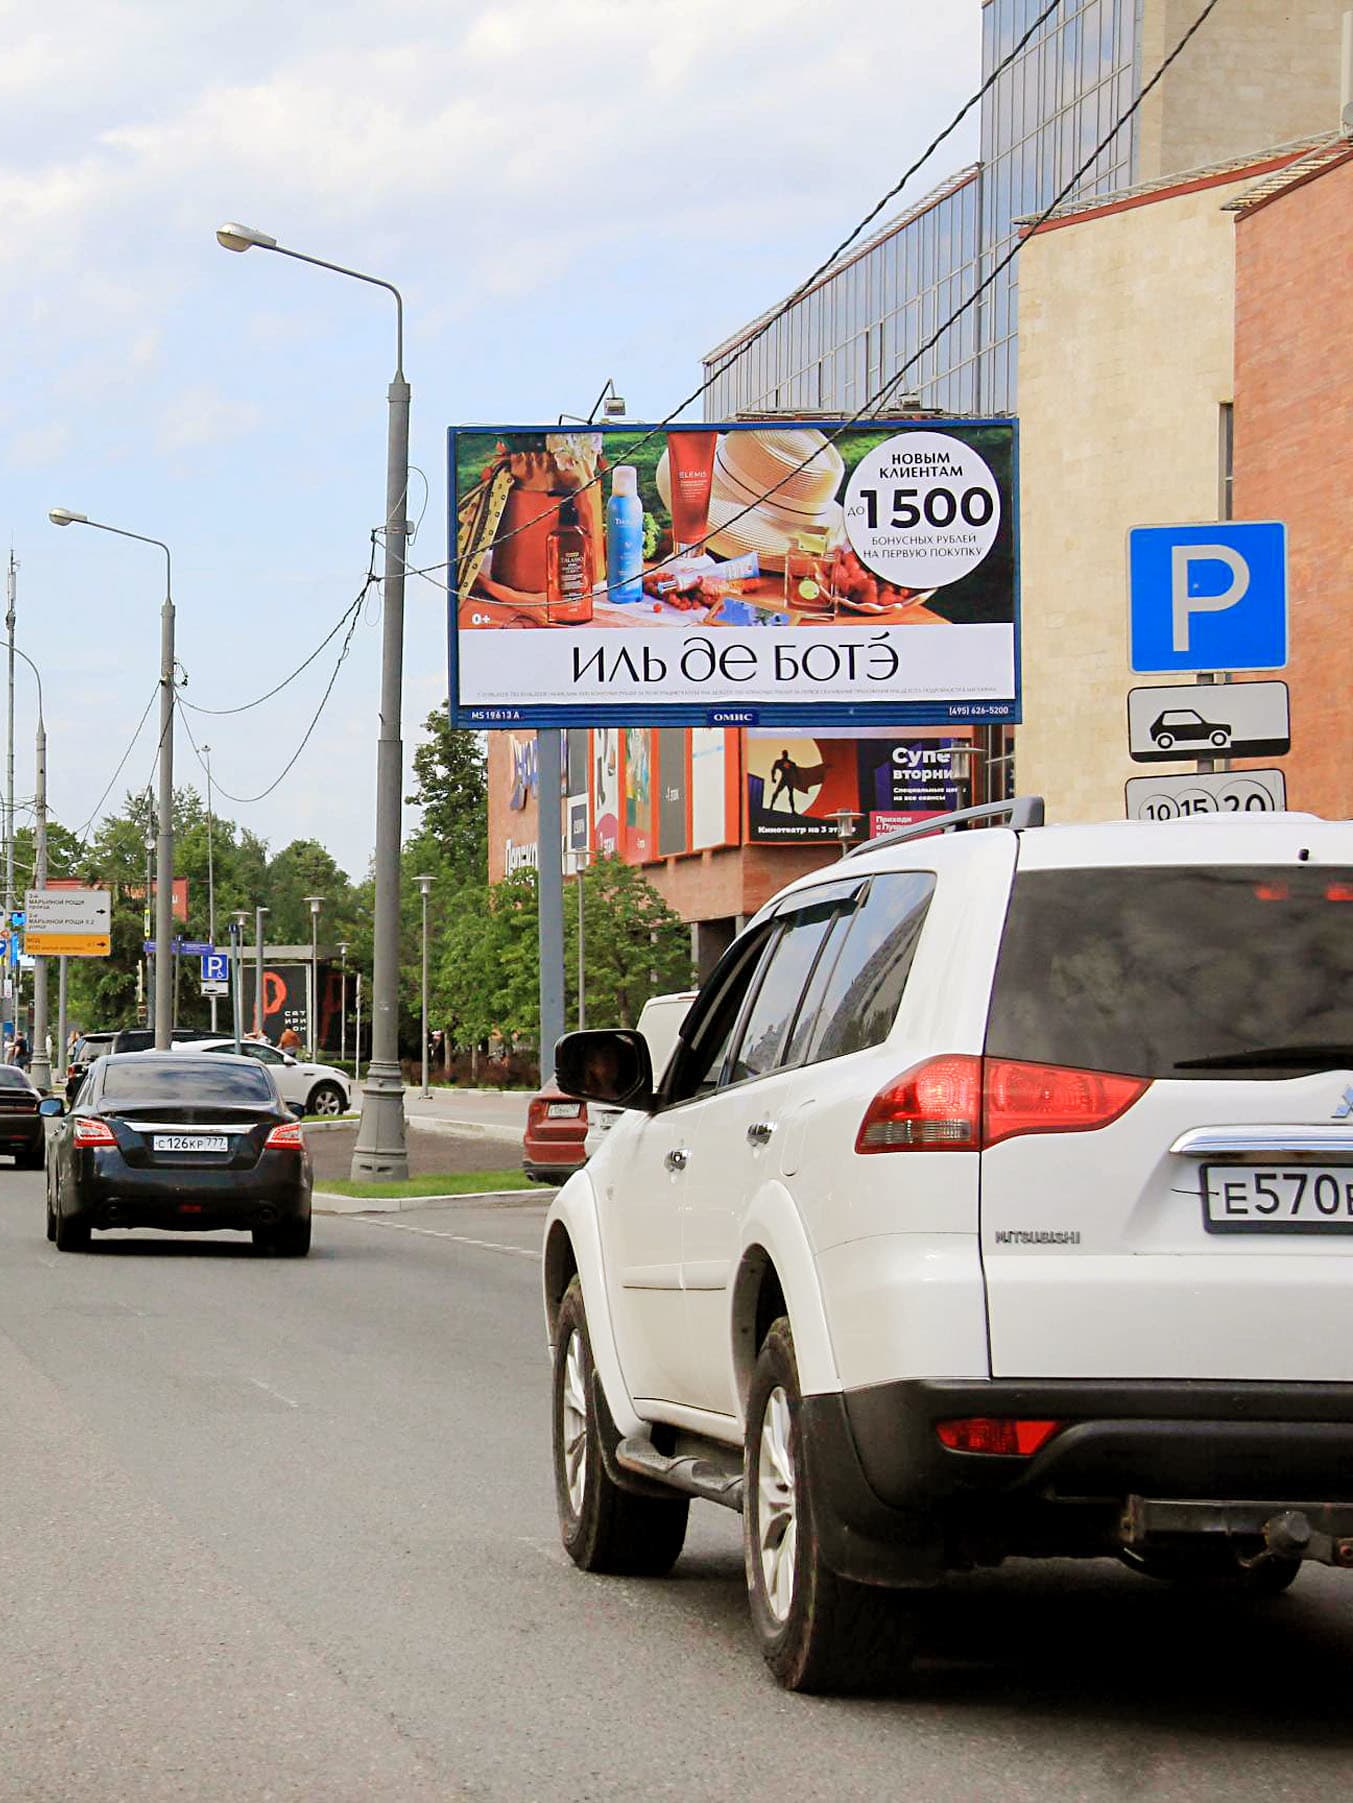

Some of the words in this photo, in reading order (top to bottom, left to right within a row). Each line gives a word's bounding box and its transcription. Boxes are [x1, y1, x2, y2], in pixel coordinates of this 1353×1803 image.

[892, 453, 950, 464] НОВЫМ
[880, 466, 963, 478] КЛИЕНТАМ
[860, 487, 994, 529] 1500
[872, 536, 934, 545] БОНУСНЫХ
[937, 533, 976, 544] РУБЛЕЙ
[863, 549, 880, 559] НА
[882, 549, 927, 559] ПЕРВУЮ
[930, 548, 982, 557] ПОКУПКУ
[1171, 544, 1250, 652] P
[472, 614, 491, 624] 0+
[573, 646, 668, 683] ИЛЬ
[713, 713, 753, 721] ОМИС
[949, 706, 969, 716] (495)
[971, 706, 1009, 714] 626-5200
[1146, 804, 1170, 821] 10
[1180, 799, 1209, 816] 15
[995, 1231, 1081, 1244] MITSUBISHI
